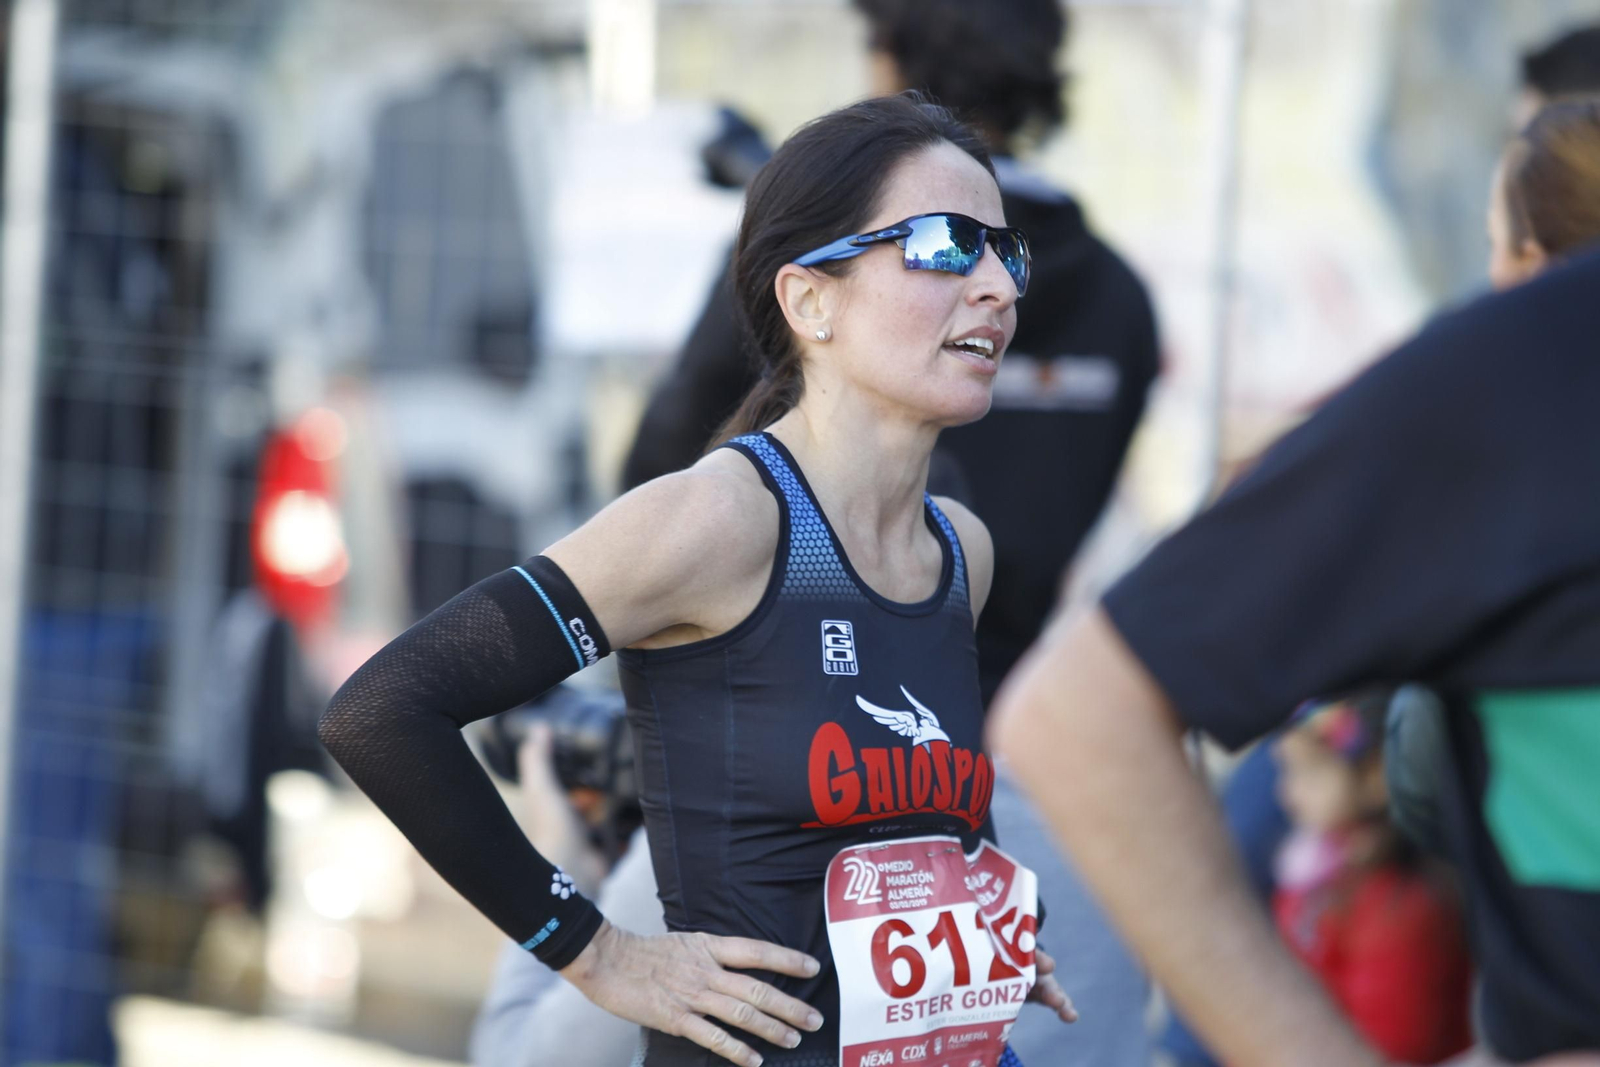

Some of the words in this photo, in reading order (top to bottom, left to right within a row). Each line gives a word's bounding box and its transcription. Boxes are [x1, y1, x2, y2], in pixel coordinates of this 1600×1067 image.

[885, 861, 914, 872] MEDIO
[886, 870, 935, 886] MARATÓN
[887, 884, 933, 901] ALMERÍA
[886, 993, 953, 1024] ESTER
